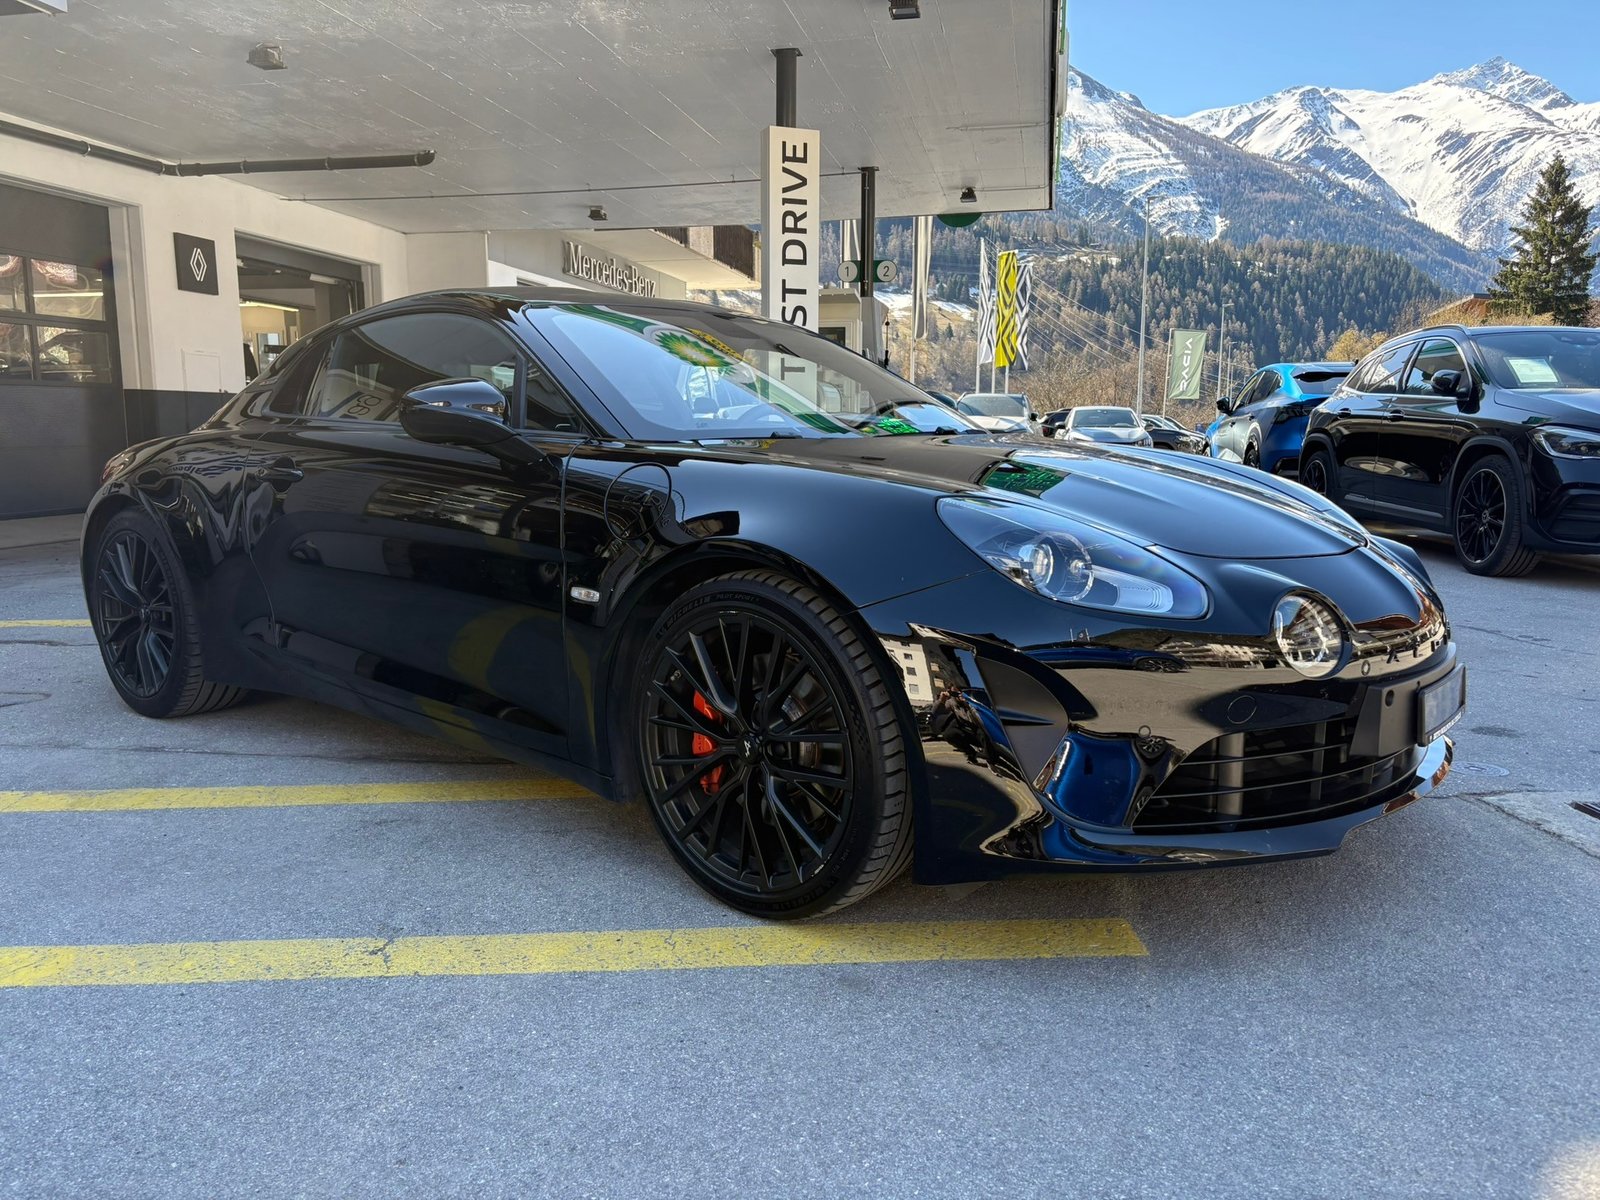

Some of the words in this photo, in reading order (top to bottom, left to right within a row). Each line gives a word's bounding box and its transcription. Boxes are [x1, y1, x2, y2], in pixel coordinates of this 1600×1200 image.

[781, 140, 808, 267] DRIVE
[567, 241, 657, 298] Mercedes-Benz
[844, 266, 850, 278] 1
[882, 265, 890, 277] 2
